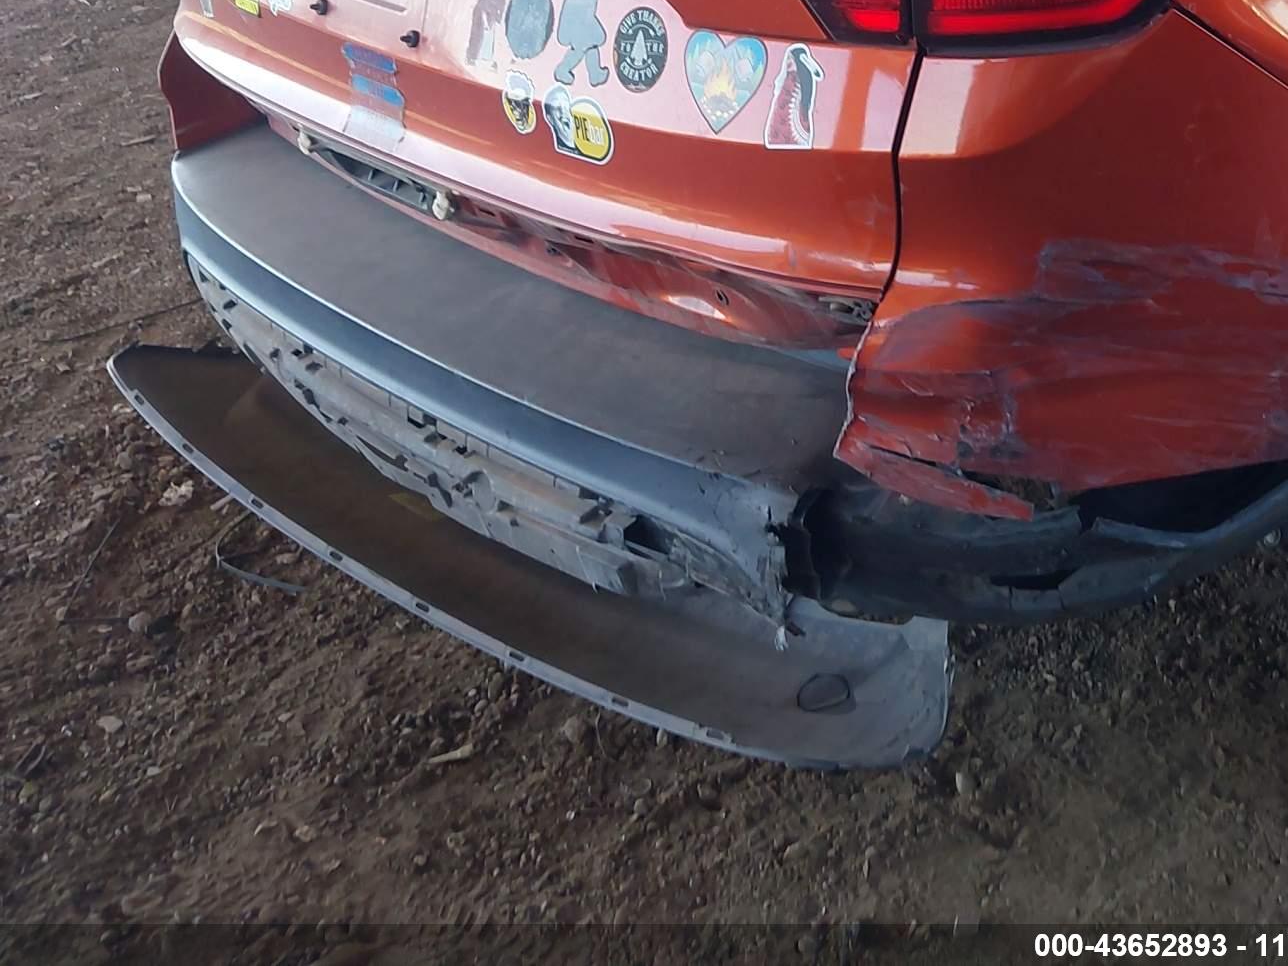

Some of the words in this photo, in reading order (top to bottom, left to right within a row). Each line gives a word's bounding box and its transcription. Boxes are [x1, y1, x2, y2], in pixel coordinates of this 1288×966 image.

[620, 12, 638, 34] GIVE
[620, 42, 632, 52] TO
[647, 42, 665, 53] THE
[620, 61, 660, 82] CREATOR
